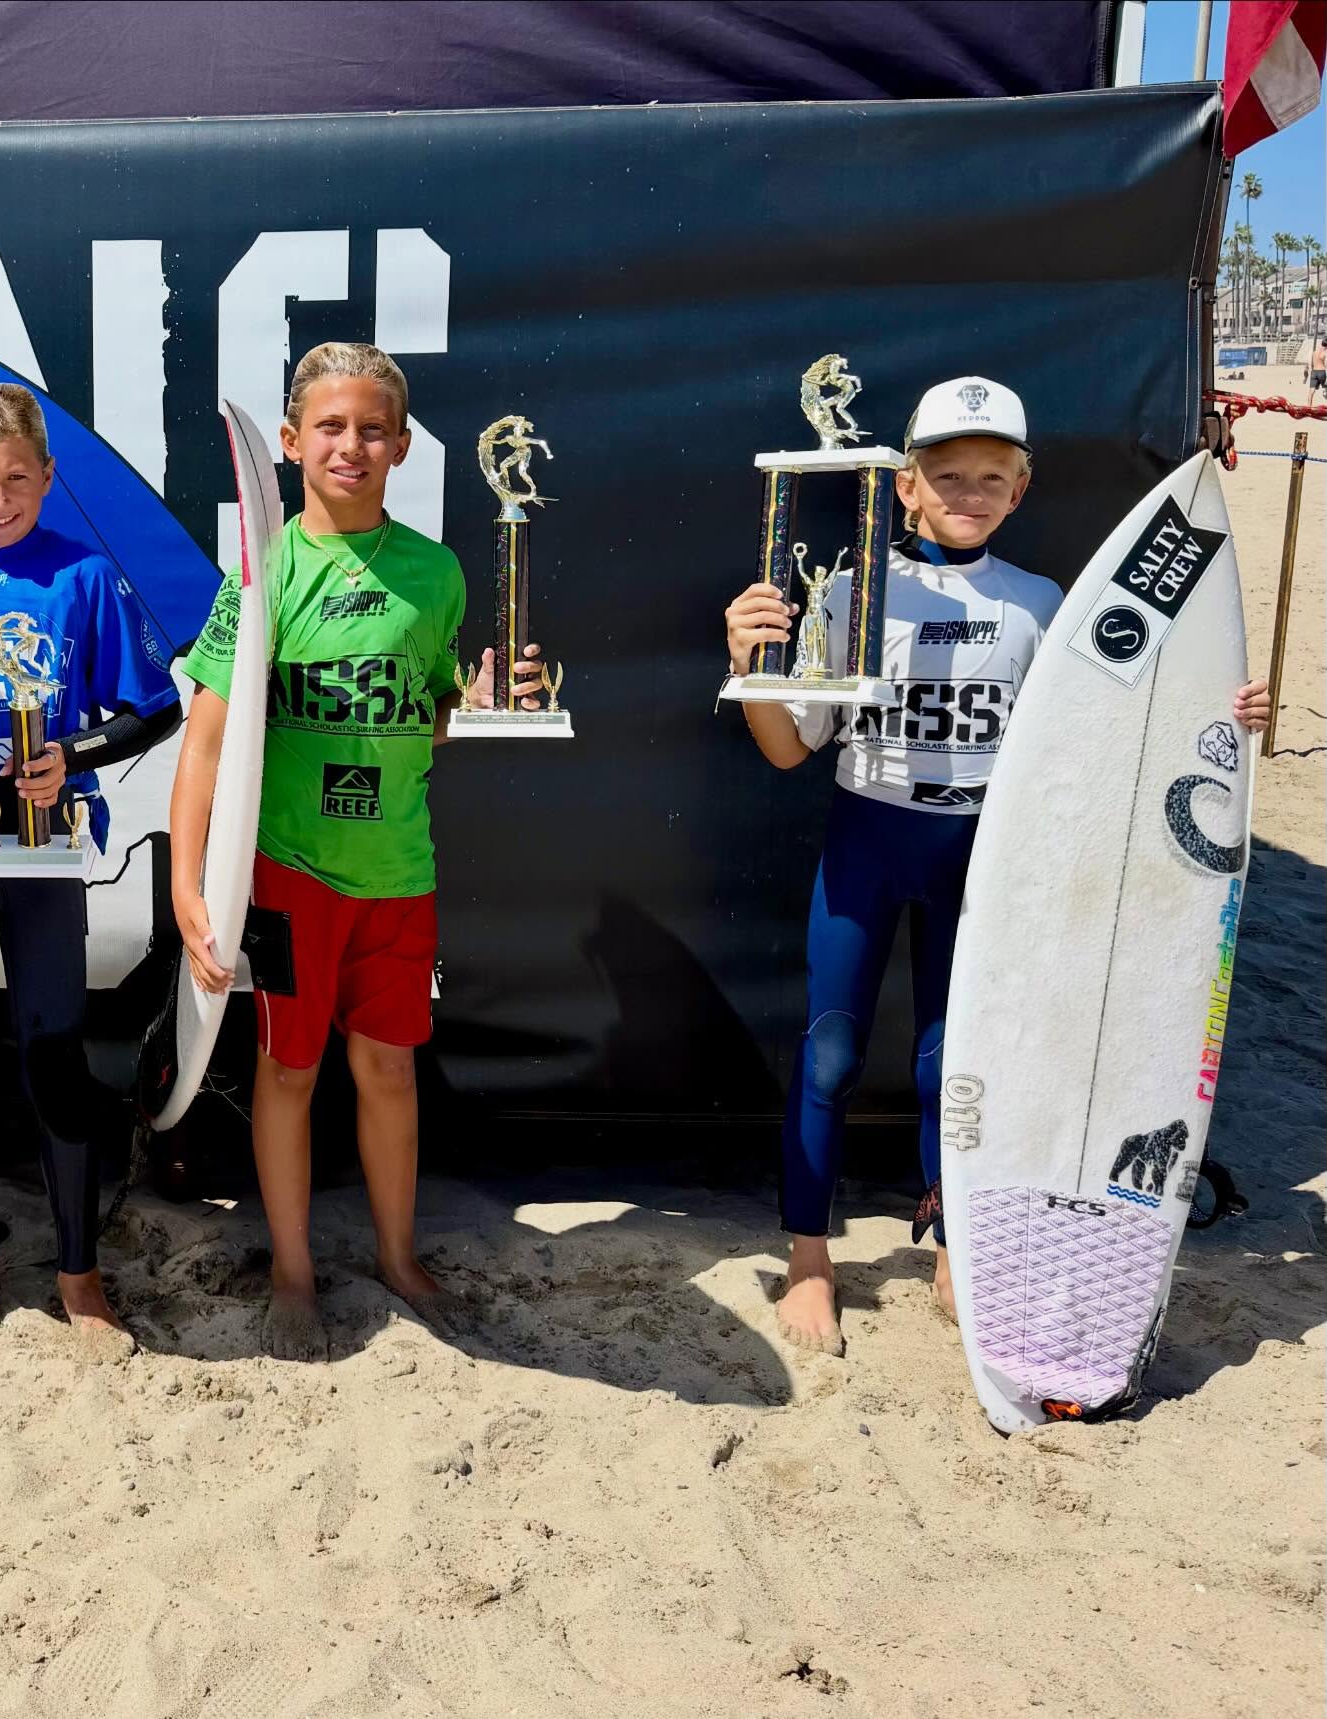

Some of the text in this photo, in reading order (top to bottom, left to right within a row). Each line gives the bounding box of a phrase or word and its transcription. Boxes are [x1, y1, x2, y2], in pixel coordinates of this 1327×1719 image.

[1128, 518, 1184, 591] SALTY
[1154, 536, 1204, 602] CREW
[266, 658, 432, 725] NSSA
[309, 721, 354, 732] SCHOLASTIC
[356, 725, 384, 734] SURFING
[855, 683, 1014, 744] NSS
[865, 736, 903, 746] NATIONAL
[905, 740, 955, 751] SCHOLASTIC
[956, 743, 987, 751] SURFING
[324, 796, 379, 817] REEF
[1047, 1195, 1106, 1217] FCS
